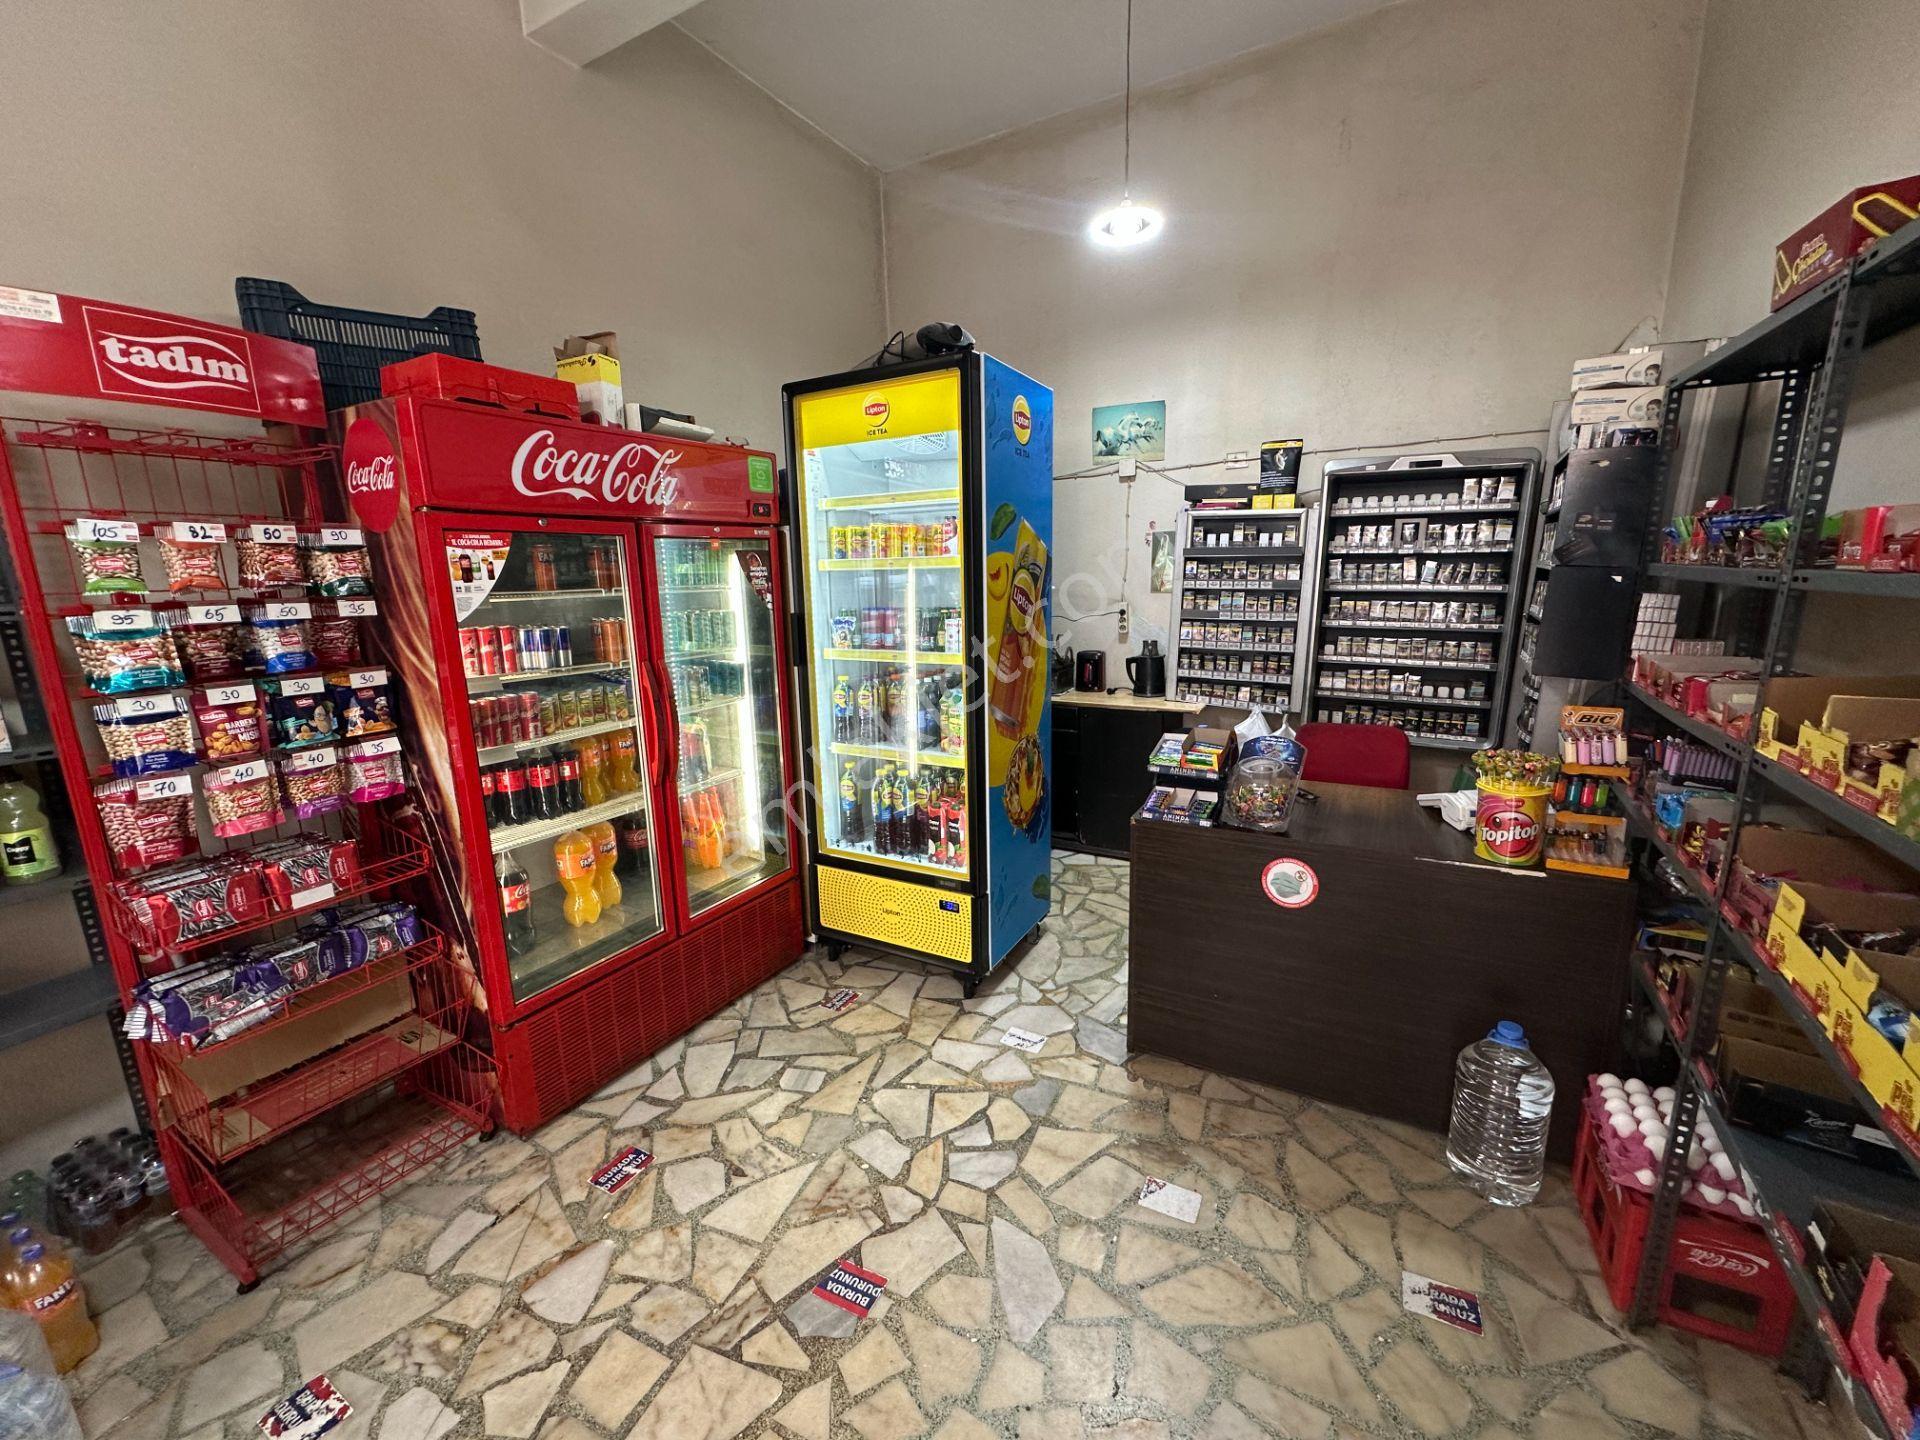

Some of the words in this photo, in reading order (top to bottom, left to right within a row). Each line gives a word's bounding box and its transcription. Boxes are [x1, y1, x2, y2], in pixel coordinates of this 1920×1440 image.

[99, 337, 248, 383] tadım
[867, 406, 886, 414] Lipton
[1015, 412, 1029, 426] Lipton
[348, 455, 394, 493] Coca-Cola
[511, 429, 684, 506] Coca-Cola
[92, 523, 118, 538] 105
[190, 525, 213, 539] 82
[331, 530, 348, 541] 90
[205, 606, 225, 620] 65
[348, 603, 366, 615] 35
[111, 613, 134, 625] 95
[359, 674, 376, 685] 30
[292, 681, 311, 693] 30
[221, 688, 241, 701] 30
[131, 700, 156, 713] 30
[371, 742, 386, 754] 35
[308, 752, 325, 766] 40
[233, 766, 255, 781] 40
[155, 782, 177, 796] 70
[1481, 823, 1539, 846] Topitop
[598, 1153, 637, 1184] BURADA
[830, 1269, 884, 1297] DURUNUZ
[827, 1280, 870, 1307] BURADA
